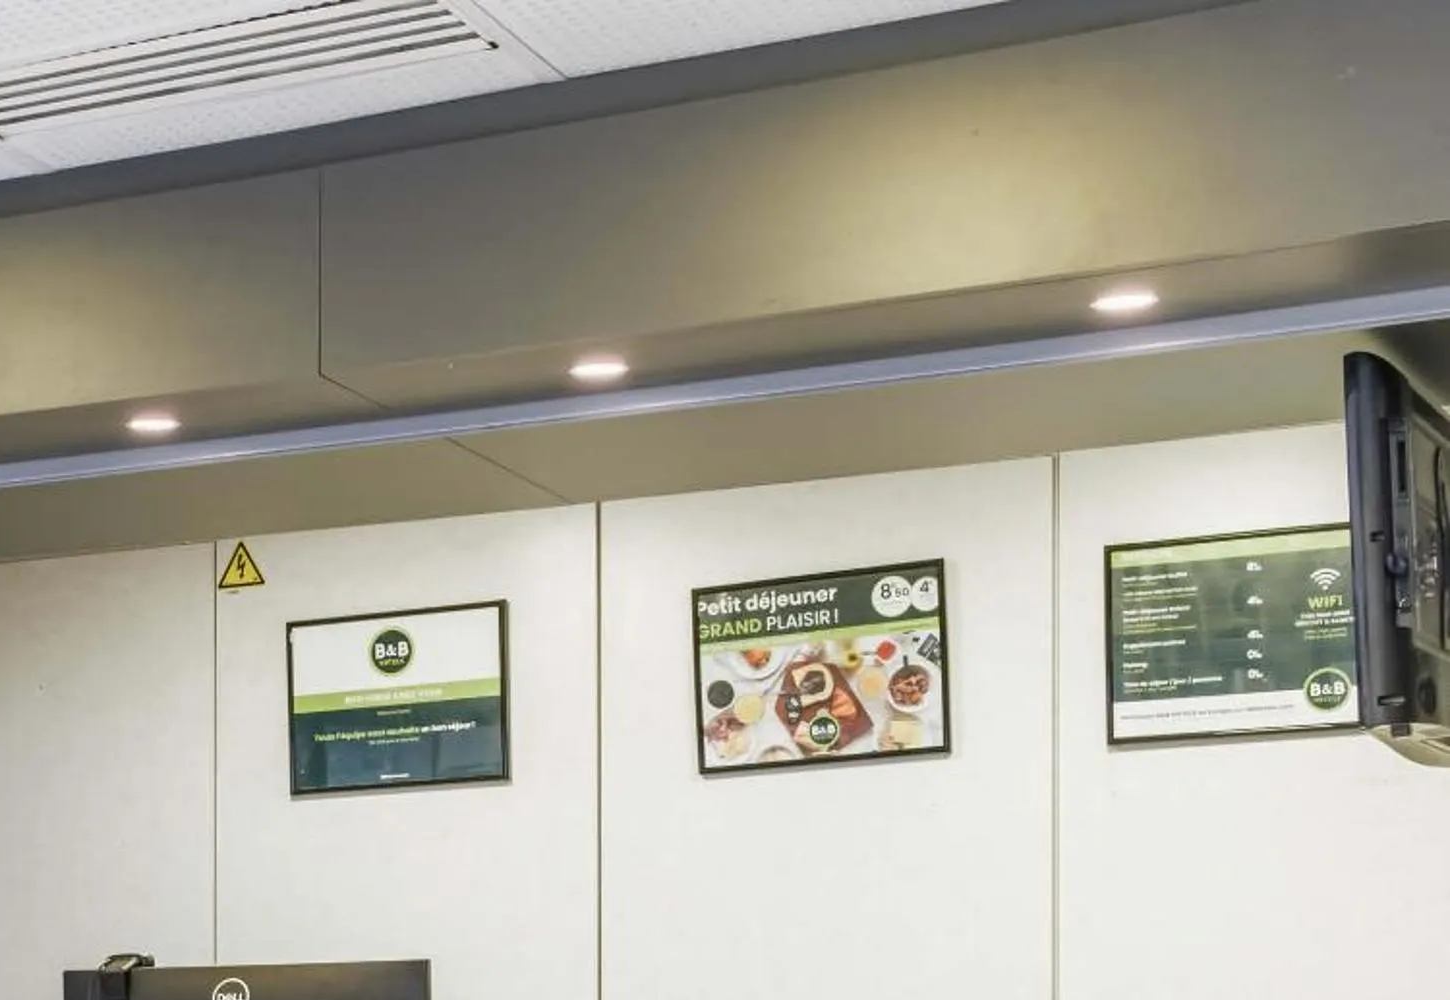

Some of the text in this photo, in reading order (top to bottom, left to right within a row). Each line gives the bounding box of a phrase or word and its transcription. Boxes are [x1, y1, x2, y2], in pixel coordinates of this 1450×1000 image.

[698, 588, 838, 616] Petit déjeuner
[1307, 594, 1343, 609] WIFI
[699, 618, 763, 639] GRAND
[766, 609, 831, 631] PLAISIR
[374, 640, 409, 660] B&B
[1310, 681, 1346, 697] B&B
